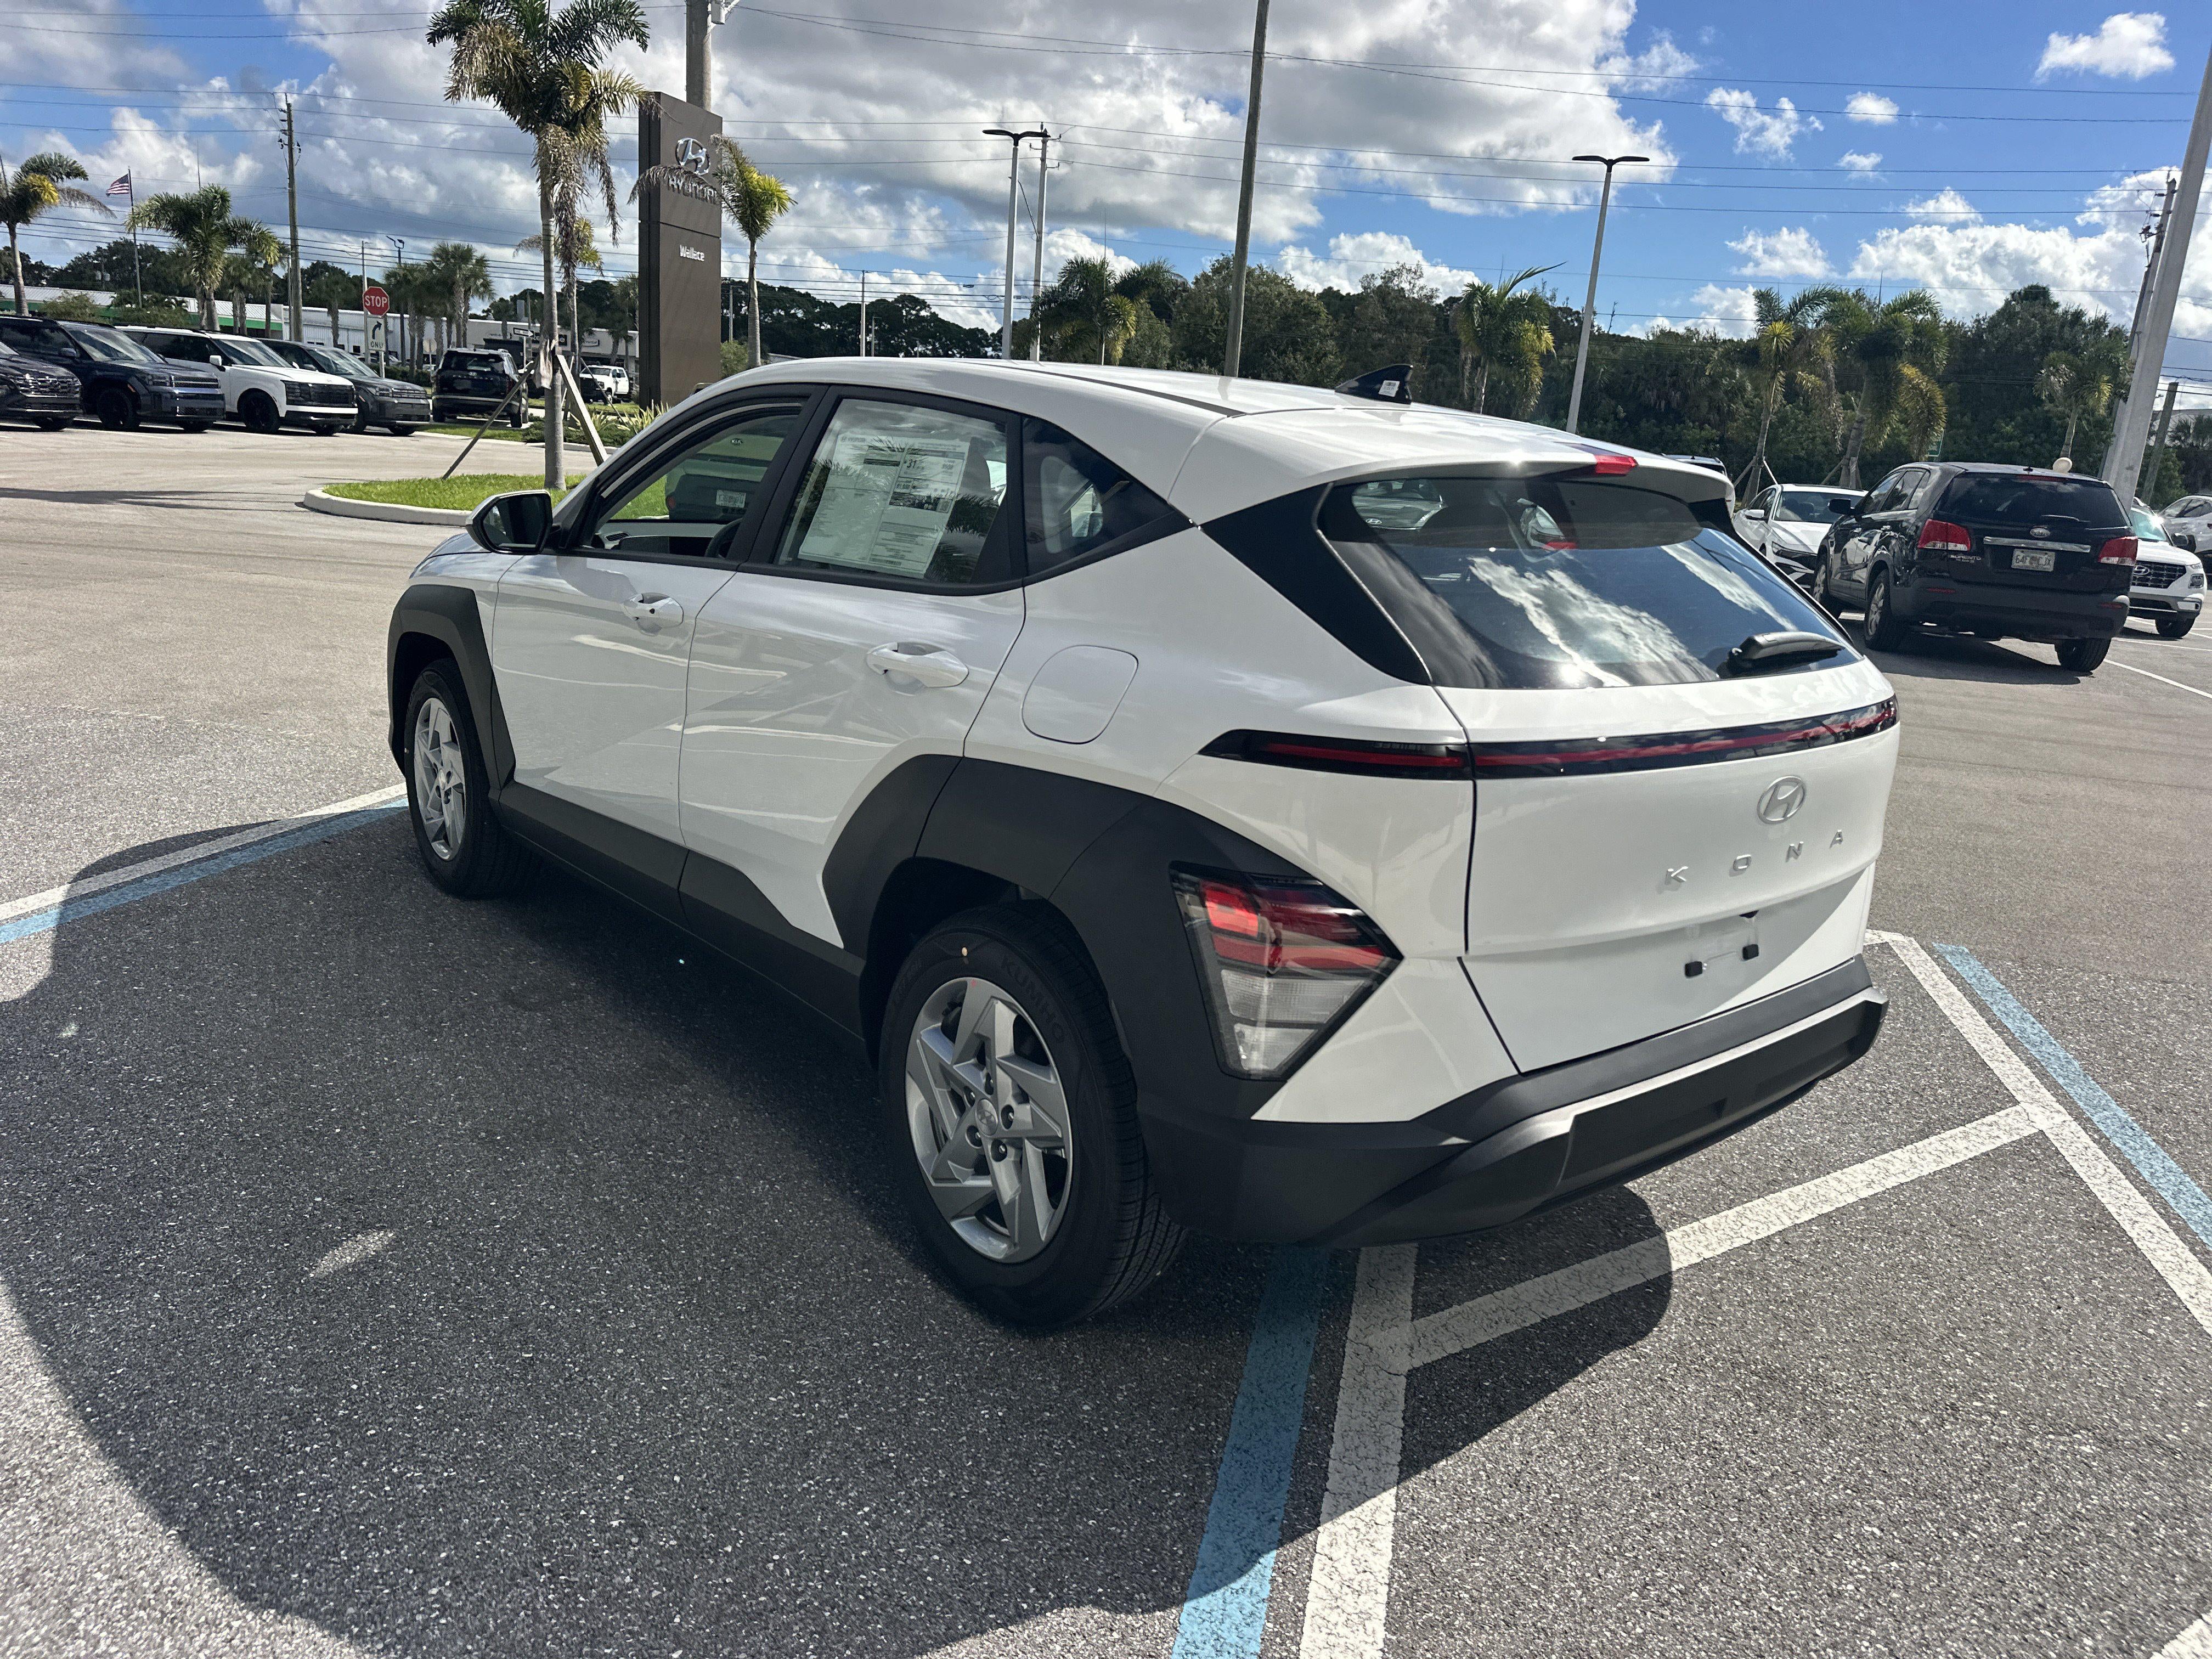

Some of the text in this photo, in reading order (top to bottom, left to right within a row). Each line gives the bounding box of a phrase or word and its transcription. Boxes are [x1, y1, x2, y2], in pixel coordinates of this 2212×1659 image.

[680, 244, 705, 261] Wallace
[364, 295, 388, 308] STOP
[1664, 830, 1845, 884] KONA
[1001, 955, 1065, 1043] KUMHO
